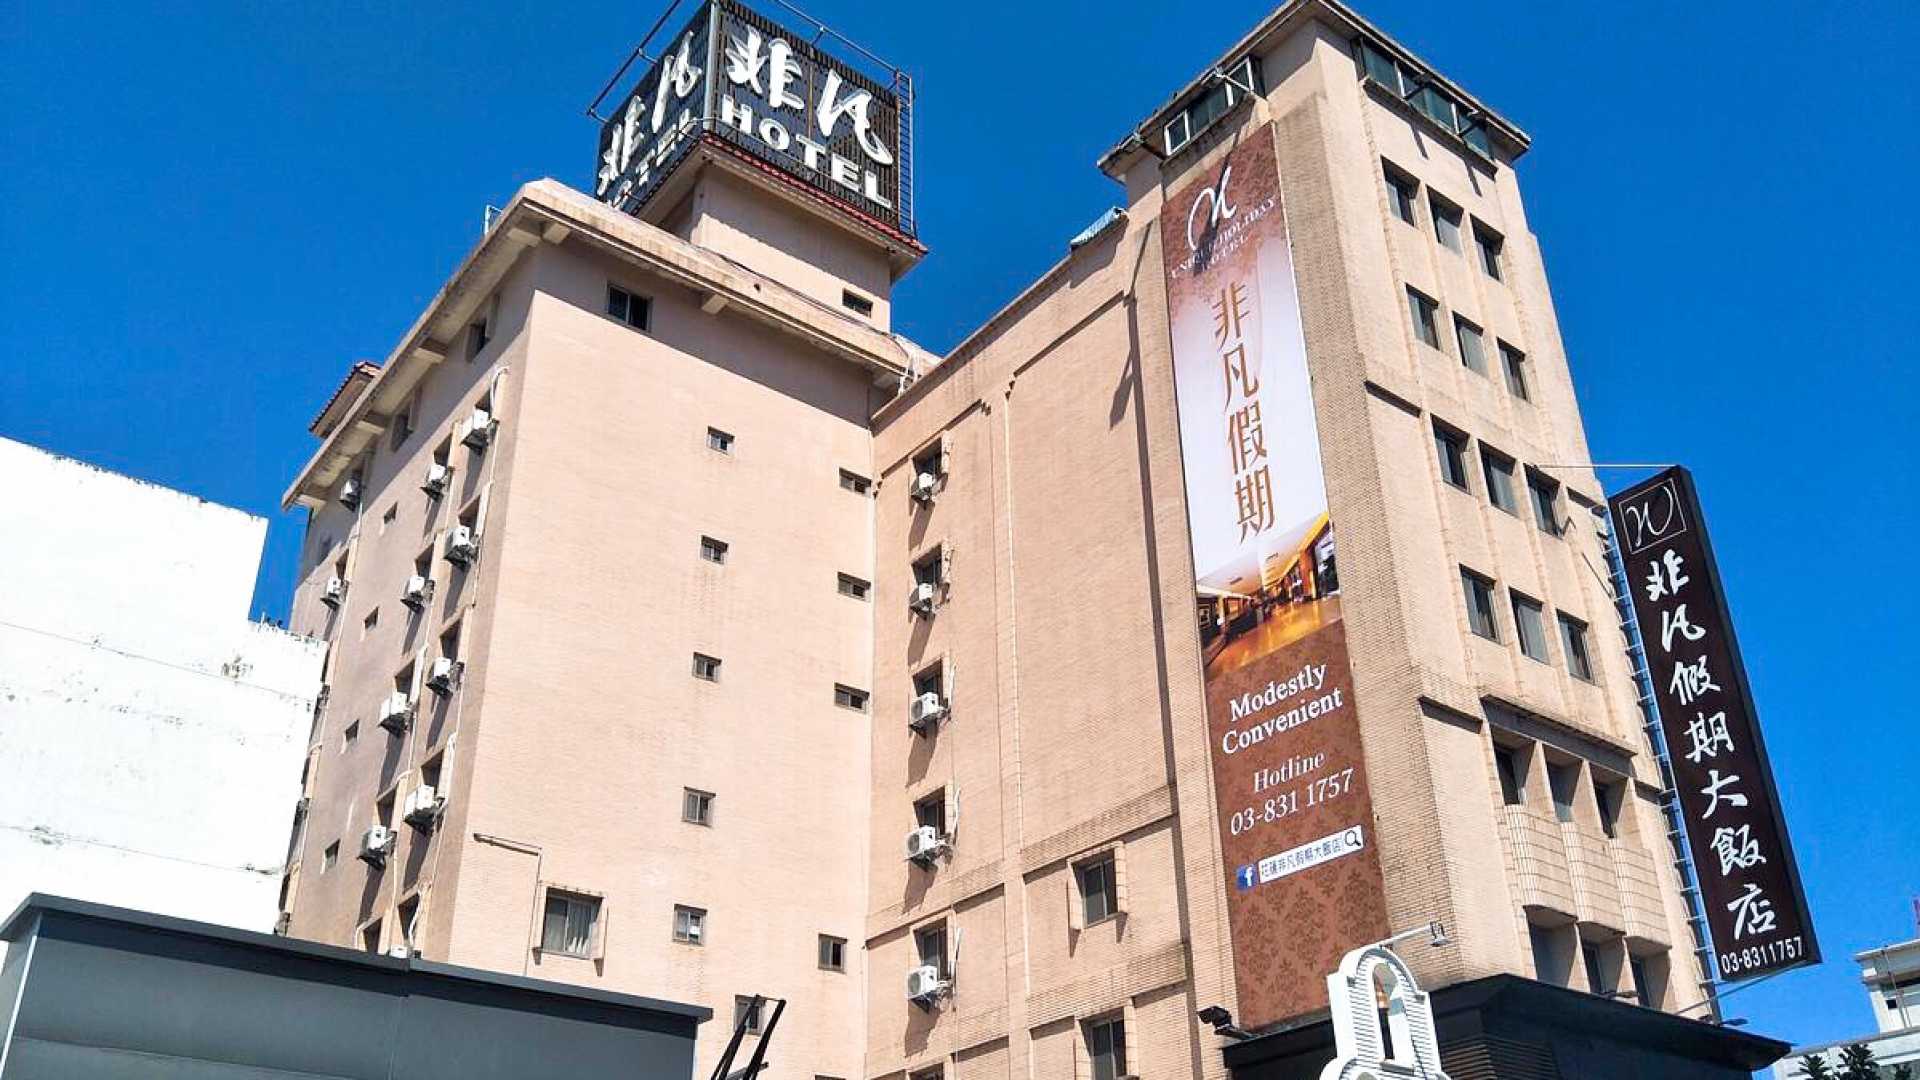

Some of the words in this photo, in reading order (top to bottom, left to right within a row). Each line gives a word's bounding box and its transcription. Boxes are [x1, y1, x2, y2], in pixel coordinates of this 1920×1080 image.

[722, 94, 891, 209] HOTEL
[1211, 281, 1274, 545] 非凡假期
[1222, 687, 1344, 754] Convenient
[1229, 664, 1327, 722] Modestly
[1253, 751, 1325, 793] Hotline
[1646, 549, 1778, 940] 非凡假期大飯店
[1230, 790, 1299, 836] 03-831
[1306, 768, 1354, 808] 1757
[1721, 936, 1803, 974] 03-8311757
